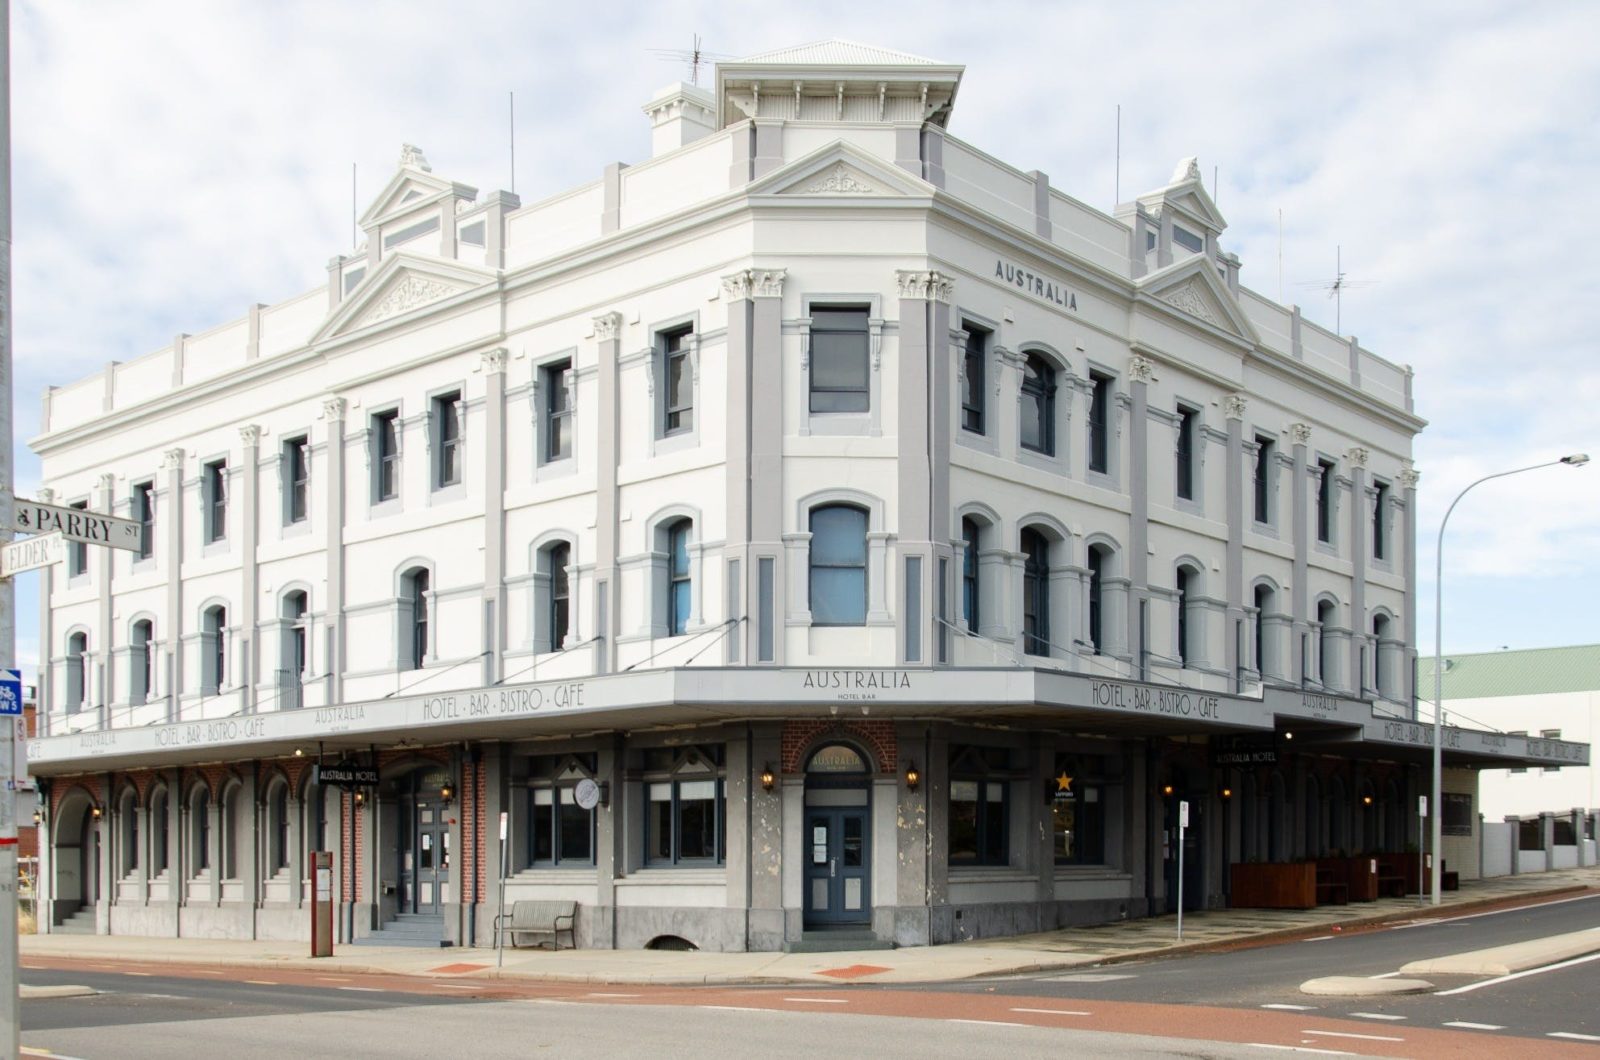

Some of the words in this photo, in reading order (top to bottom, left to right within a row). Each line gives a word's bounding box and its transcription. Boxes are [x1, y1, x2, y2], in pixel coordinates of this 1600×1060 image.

[996, 260, 1077, 312] AUSTRALIA
[36, 508, 113, 542] PARRY
[125, 525, 139, 537] ST
[9, 539, 48, 570] ELDER
[804, 671, 911, 688] AUSTRALIA
[424, 697, 459, 720] HOTEL
[470, 693, 490, 716] BAR
[501, 688, 543, 713] BISTRO
[554, 683, 584, 708] CAFE
[1092, 681, 1126, 708] HOTEL
[1134, 687, 1151, 710] BAR
[1159, 691, 1191, 715] BISTRO
[1198, 696, 1219, 719] CAFE
[1302, 693, 1338, 711] AUSTRALIA
[315, 705, 365, 724] AUSTRALIA
[155, 727, 180, 746] HOTEL
[187, 725, 201, 744] BAR
[208, 721, 237, 742] BISTRO
[245, 718, 265, 738] CAFE
[1384, 720, 1404, 741] HOTEL
[1409, 725, 1419, 743] BAR
[1252, 752, 1276, 762] HOTEL
[320, 770, 353, 781] AUSTRALIA
[355, 771, 378, 782] HOTEL
